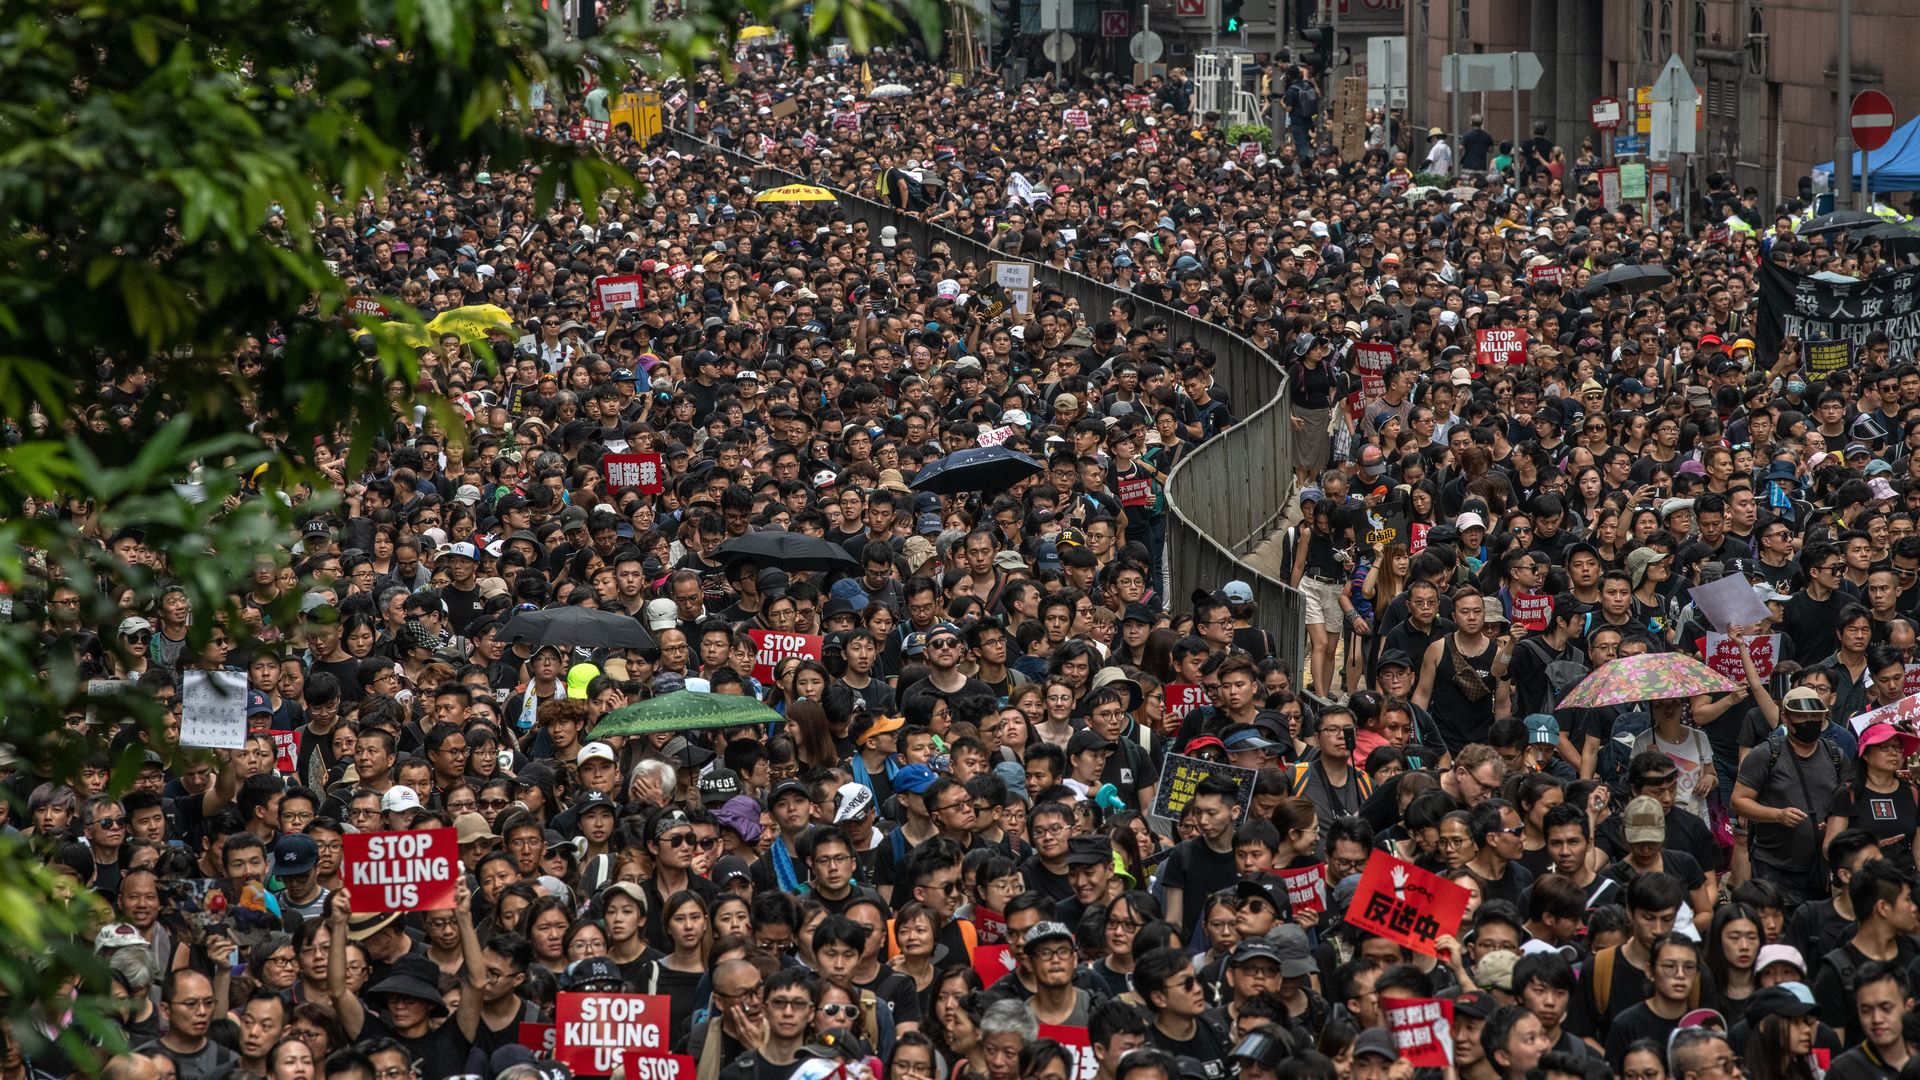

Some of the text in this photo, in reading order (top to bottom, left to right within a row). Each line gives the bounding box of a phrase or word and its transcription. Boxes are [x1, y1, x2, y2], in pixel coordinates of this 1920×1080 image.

[355, 299, 380, 310] STOP
[1794, 292, 1913, 319] 殺人政權
[1479, 341, 1522, 353] KILLING
[1486, 330, 1515, 342] STOP
[1494, 352, 1508, 362] US
[608, 461, 657, 486] 別殺我
[308, 522, 323, 531] NY
[763, 633, 806, 650] STOP
[1721, 658, 1743, 667] CARRI
[368, 834, 432, 860] STOP
[352, 857, 449, 884] KILLING
[384, 884, 418, 908] US
[1364, 890, 1440, 942] 反送中
[580, 998, 645, 1021] STOP
[564, 1022, 659, 1047] KILLING
[594, 1047, 624, 1072] US
[638, 1056, 680, 1080] STOP
